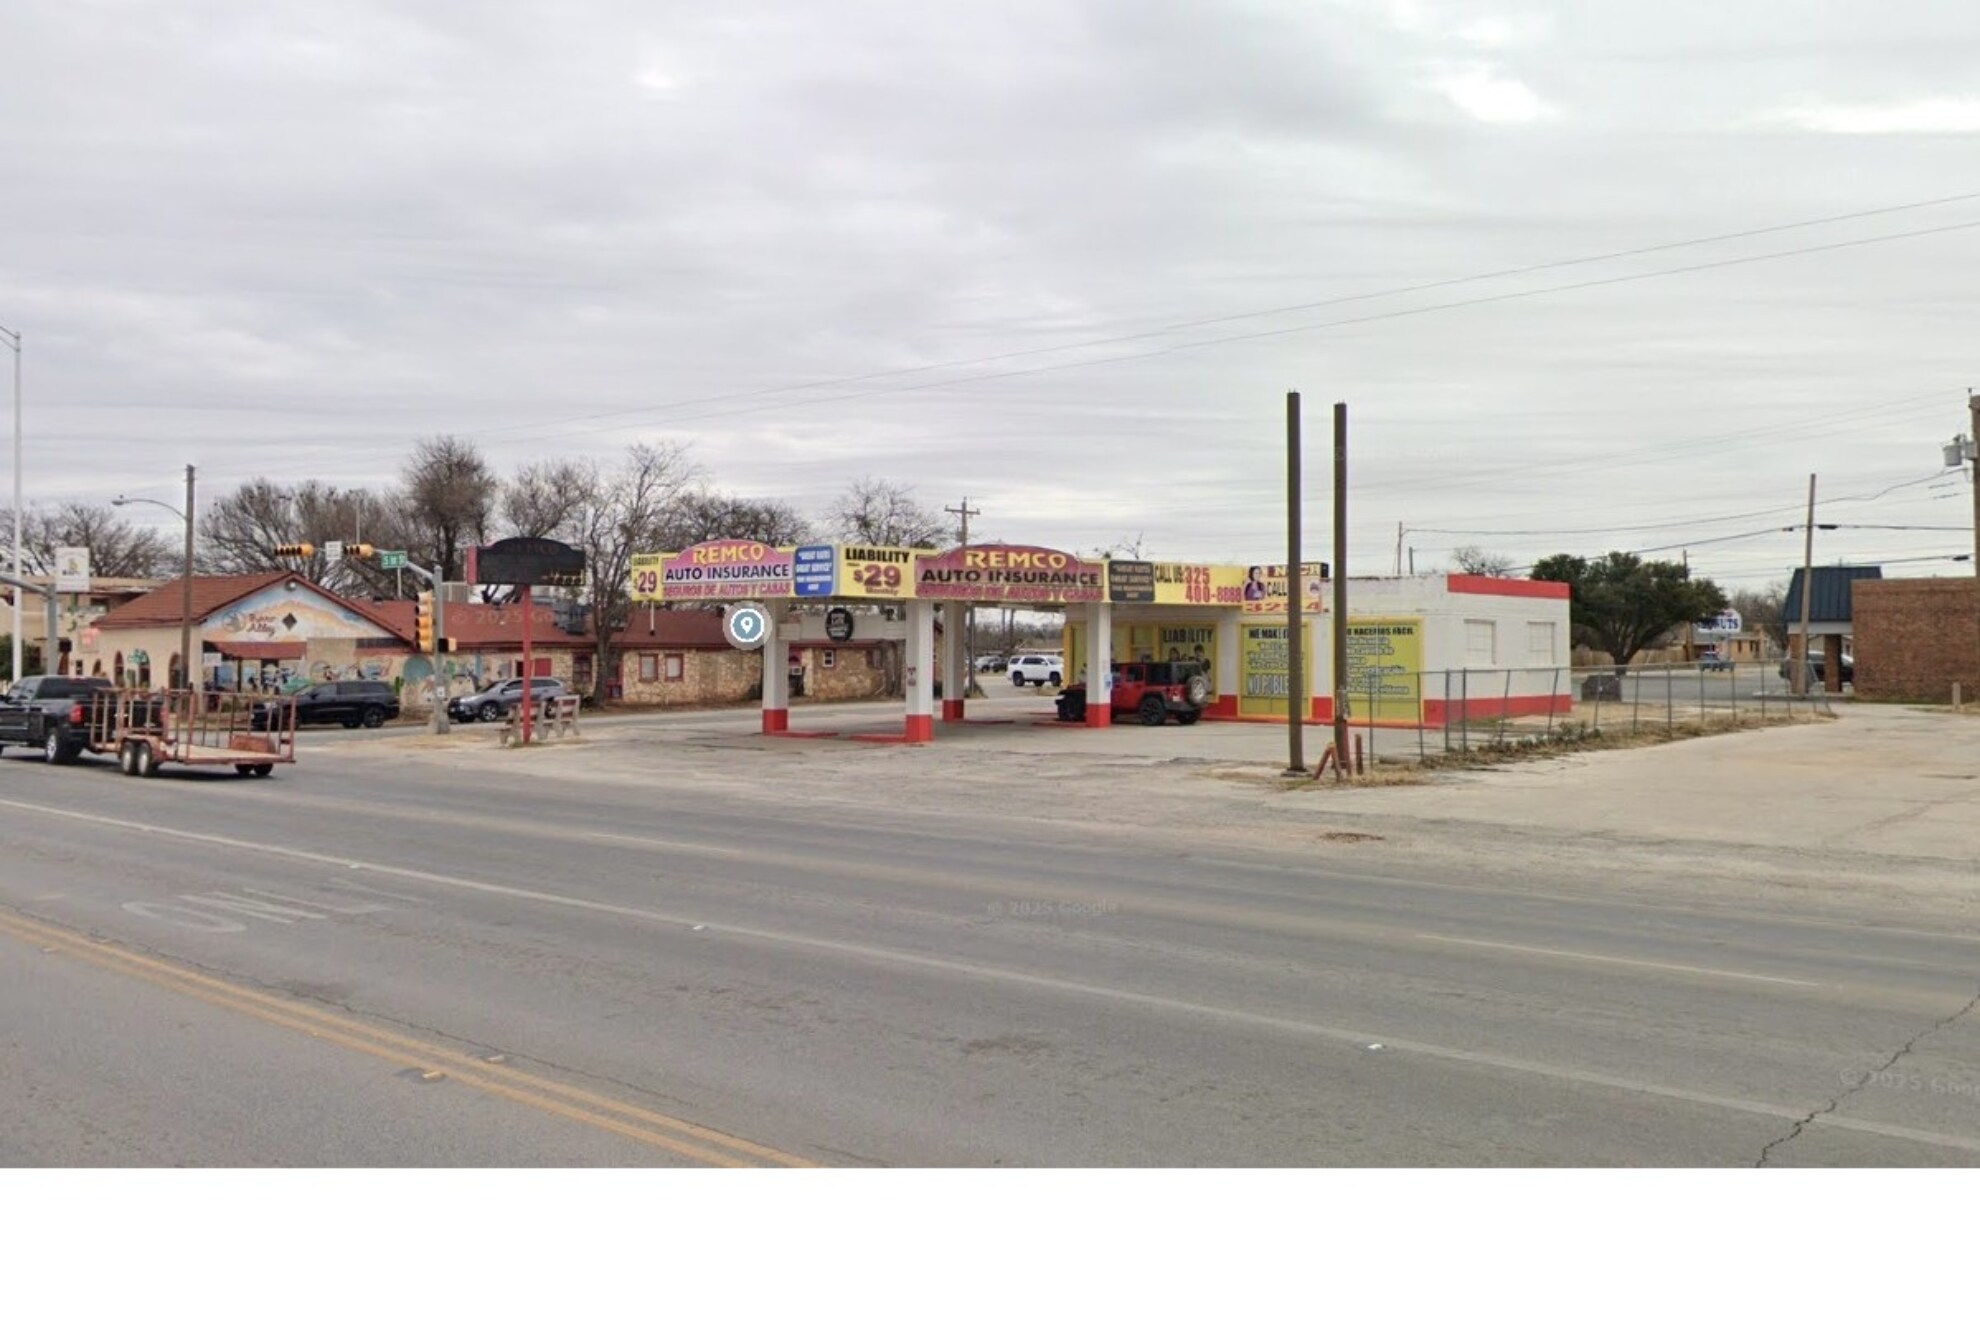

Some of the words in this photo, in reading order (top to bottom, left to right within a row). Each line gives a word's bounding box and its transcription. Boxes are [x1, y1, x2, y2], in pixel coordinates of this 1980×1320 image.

[692, 544, 765, 564] REMCO
[845, 548, 910, 563] LIABILITY
[965, 550, 1067, 568] REMCO
[665, 568, 702, 580] AUTO
[707, 564, 789, 578] INSURANCE
[853, 564, 902, 588] $29
[921, 569, 981, 582] AUTO
[988, 571, 1098, 585] INSURANCE
[1185, 567, 1211, 585] 325
[1163, 628, 1214, 642] LIABILITY
